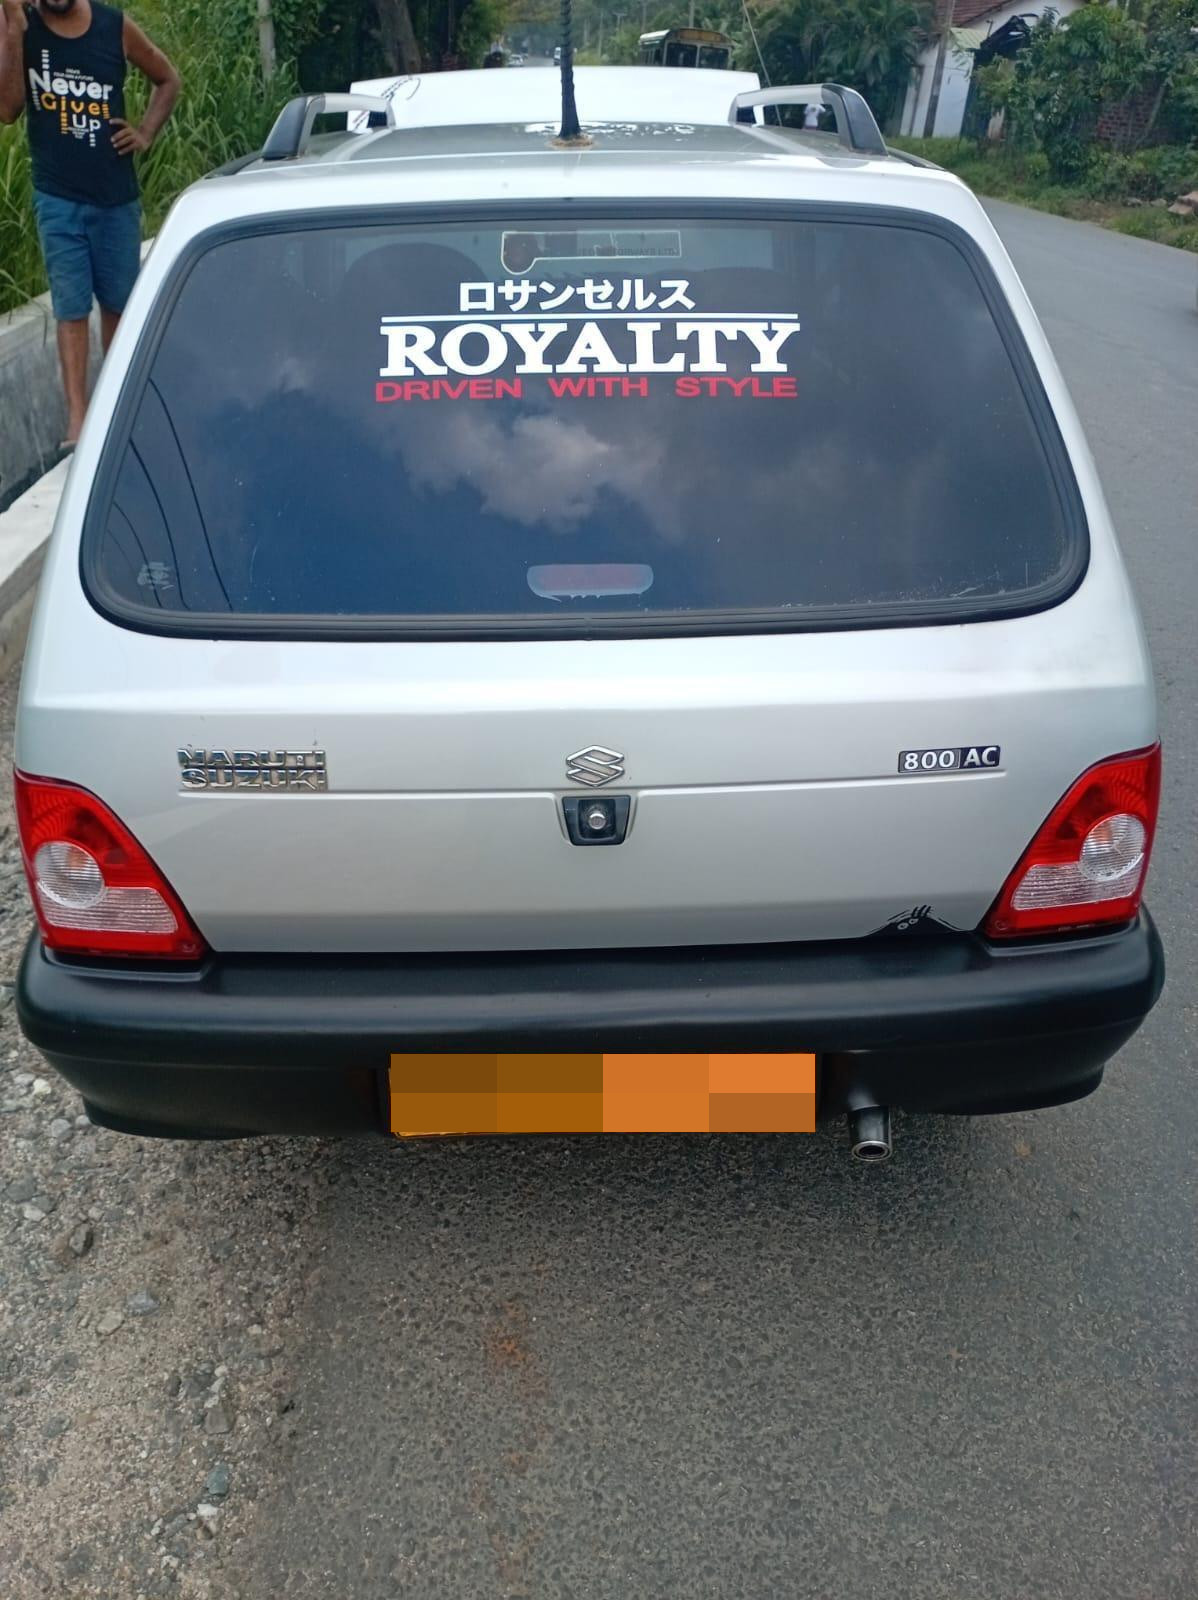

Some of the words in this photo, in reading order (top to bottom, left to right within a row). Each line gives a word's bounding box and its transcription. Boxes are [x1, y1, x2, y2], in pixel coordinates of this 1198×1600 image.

[28, 67, 113, 100] Never
[459, 279, 696, 312] ロサンゼルス
[379, 321, 801, 377] ROYALTY
[375, 378, 522, 402] DRIVEN
[547, 376, 649, 398] WITH
[675, 376, 798, 398] STYLE
[177, 749, 326, 769] MARUTI
[904, 751, 955, 770] 800
[962, 746, 998, 767] AC
[180, 768, 328, 791] SUZUKI
